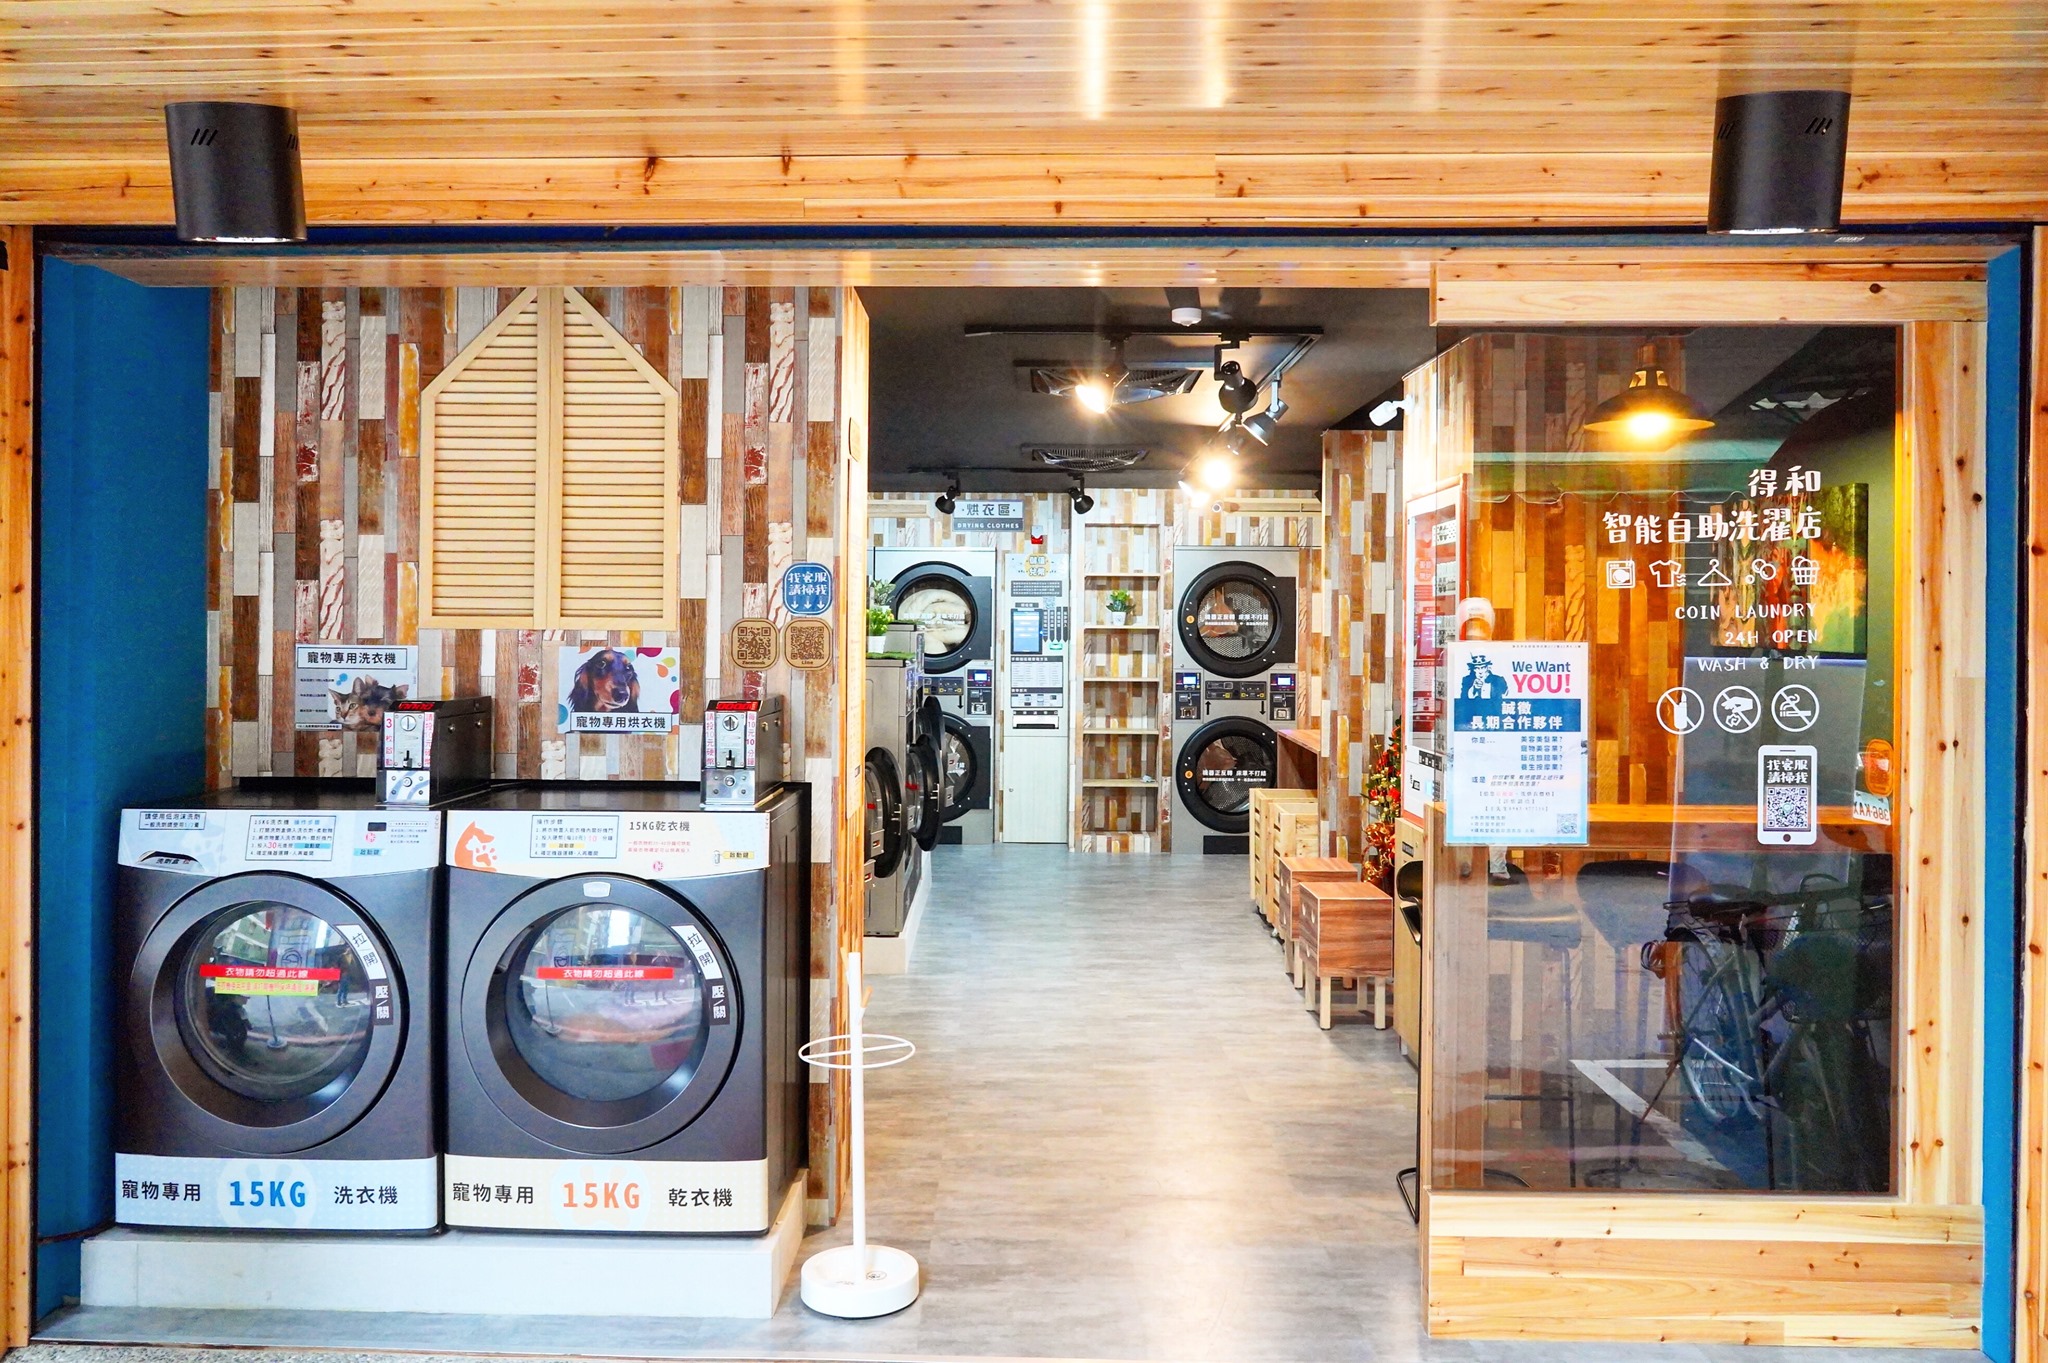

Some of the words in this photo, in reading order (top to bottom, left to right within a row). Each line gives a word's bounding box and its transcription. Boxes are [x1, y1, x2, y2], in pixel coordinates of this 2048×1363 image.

[1748, 465, 1821, 498] 得和
[966, 503, 1010, 516] 烘衣區
[1602, 505, 1822, 545] 智能自助洗濯店
[788, 571, 828, 583] 找客服
[788, 584, 828, 595] 請掃我
[1675, 605, 1720, 620] COIN
[1735, 602, 1817, 618] LAUNDRY
[1725, 631, 1759, 645] 24H
[1772, 629, 1818, 644] OPEN
[307, 651, 397, 664] 寵物專用洗衣機
[1698, 657, 1746, 672] WASH
[1760, 656, 1769, 670] &
[1783, 655, 1818, 670] DRY
[1512, 661, 1532, 672] We
[1535, 661, 1571, 672] Want
[1512, 674, 1571, 694] YOU!
[1501, 701, 1531, 715] 誠徵
[576, 716, 666, 729] 寵物專用烘衣機
[1471, 715, 1563, 730] 長期合作夥伴
[1767, 758, 1808, 771] 找客服
[1767, 771, 1808, 784] 請掃我
[629, 820, 690, 832] 15KG乾衣機
[122, 1180, 201, 1202] 寵物專用
[229, 1181, 306, 1207] 15KG
[333, 1185, 399, 1205] 洗衣機
[452, 1182, 534, 1204] 寵物專用
[563, 1182, 640, 1209] 15KG
[668, 1188, 733, 1208] 乾衣機
